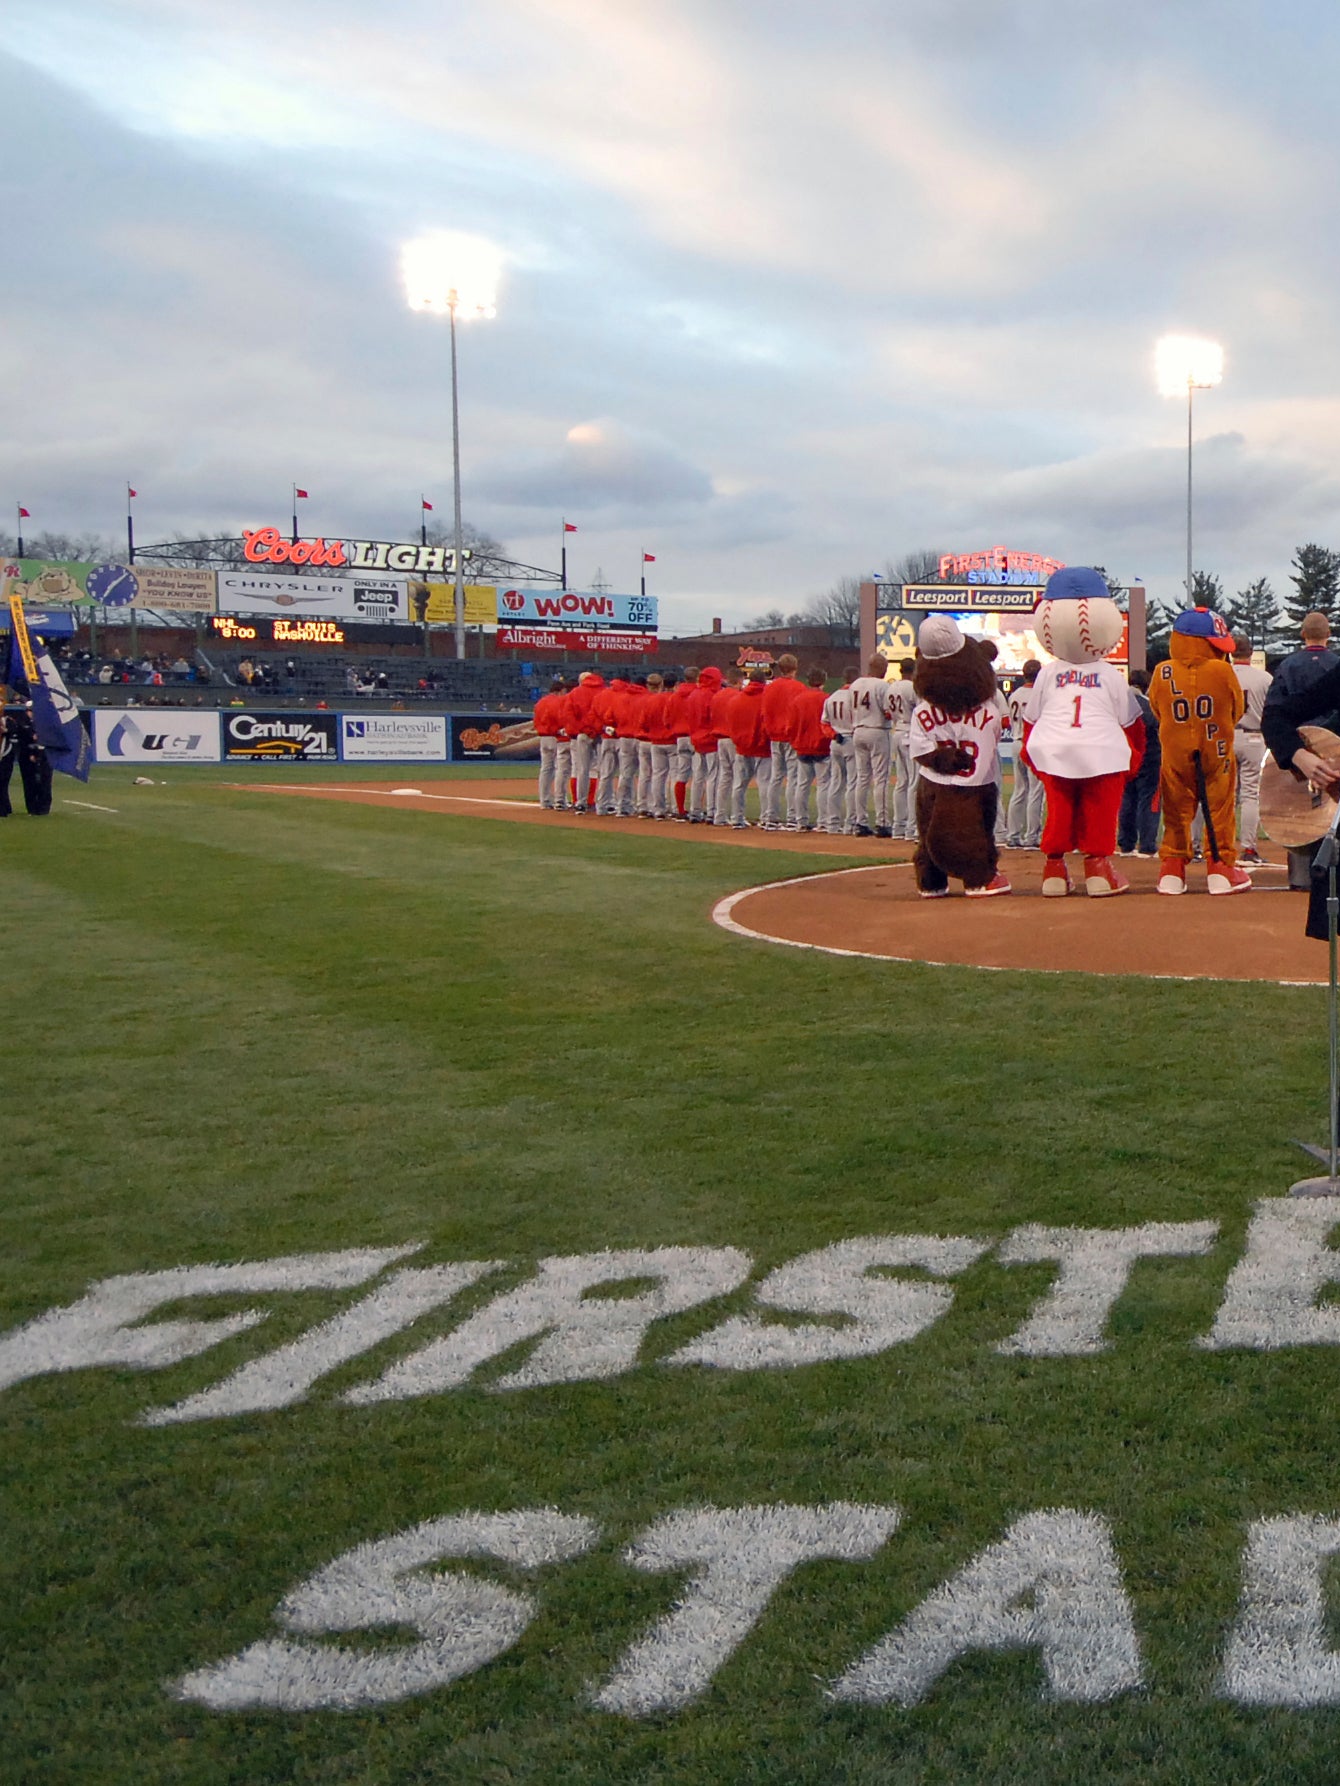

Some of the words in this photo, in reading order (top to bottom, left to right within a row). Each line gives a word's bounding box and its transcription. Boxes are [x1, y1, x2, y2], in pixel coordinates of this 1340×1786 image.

[242, 527, 347, 566] Coors
[351, 542, 472, 573] LIGHT
[354, 580, 377, 588] ONLY
[967, 571, 1039, 584] STADIUM
[225, 580, 343, 592] CHRYSLER
[360, 590, 393, 603] Jeep
[910, 590, 967, 605] Leesport
[974, 591, 1031, 605] Leesport
[534, 594, 615, 618] WOW!
[213, 618, 239, 629] NHL
[628, 613, 653, 623] OFF
[273, 621, 290, 631] ST
[297, 621, 336, 633] LOUIS
[273, 630, 344, 642] NASHVILLE
[503, 630, 557, 648] Albright
[587, 635, 633, 644] DIFFERENT
[853, 690, 870, 710] 14
[833, 701, 843, 719] 11
[1071, 695, 1082, 728] 1
[229, 715, 312, 742] Century
[366, 721, 442, 735] Harleysville
[141, 734, 201, 750] UGI
